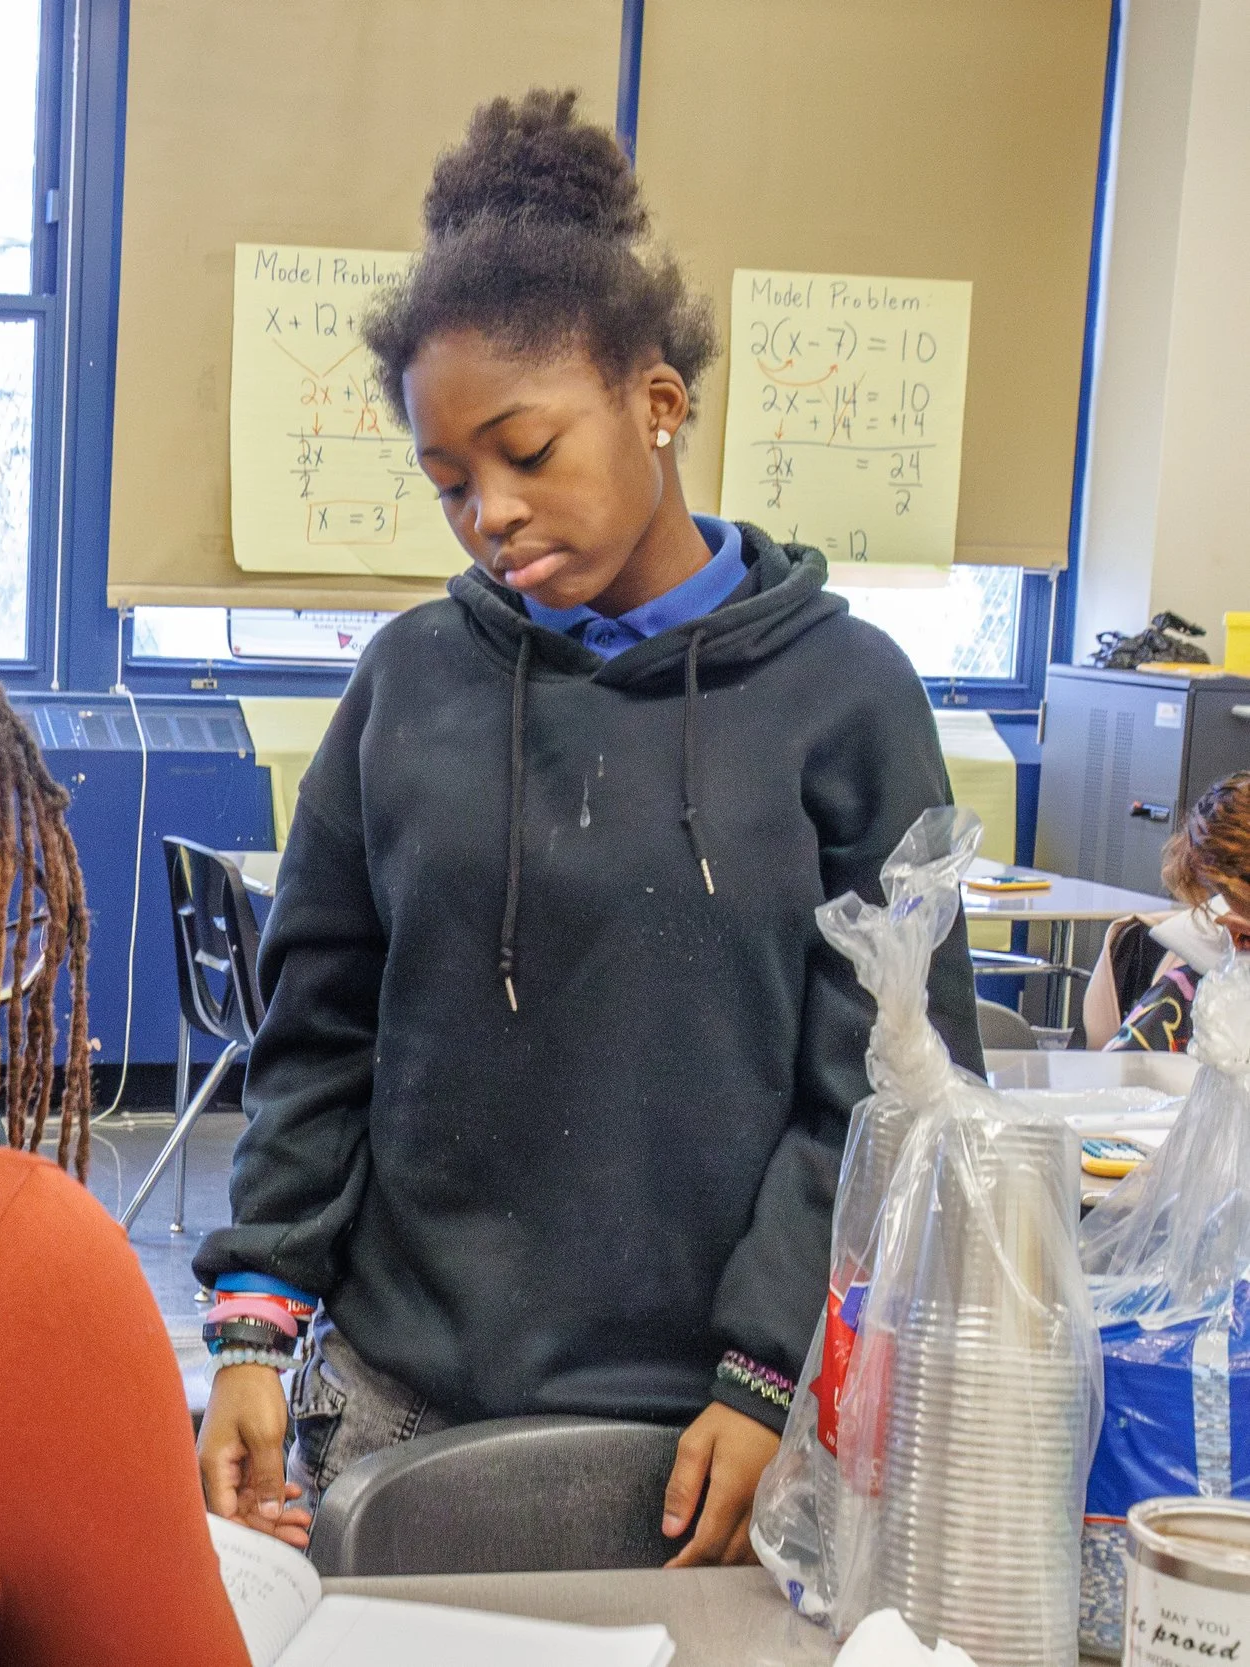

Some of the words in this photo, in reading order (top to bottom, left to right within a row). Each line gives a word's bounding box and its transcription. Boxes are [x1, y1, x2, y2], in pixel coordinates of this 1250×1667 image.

[255, 249, 321, 287] Model
[334, 258, 401, 285] Problem
[751, 277, 813, 309] Model
[315, 302, 338, 337] 12
[902, 328, 937, 363] 10
[901, 379, 930, 413] 10
[890, 450, 921, 481] 24
[895, 488, 911, 516] 2
[373, 506, 385, 532] 3
[849, 529, 868, 562] 12
[1160, 1607, 1188, 1626] MAY
[1196, 1618, 1231, 1637] YOU
[1151, 1624, 1242, 1661] proud
